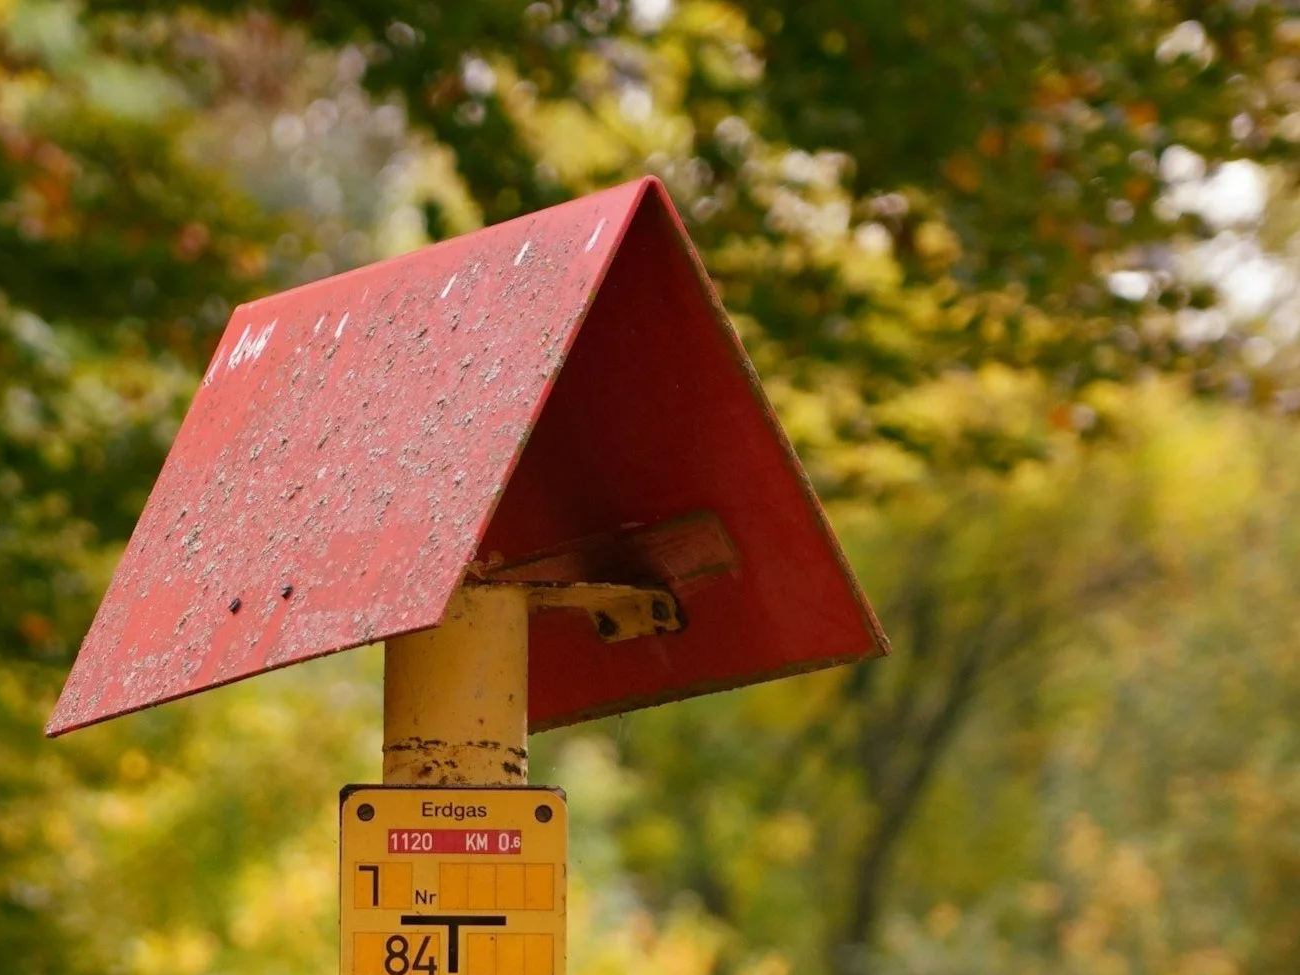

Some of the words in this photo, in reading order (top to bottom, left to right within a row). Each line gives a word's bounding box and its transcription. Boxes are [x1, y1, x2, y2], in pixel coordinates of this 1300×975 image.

[422, 802, 487, 821] Erdgas
[390, 832, 433, 851] 1120
[465, 833, 488, 851] KM
[415, 889, 437, 905] Nr
